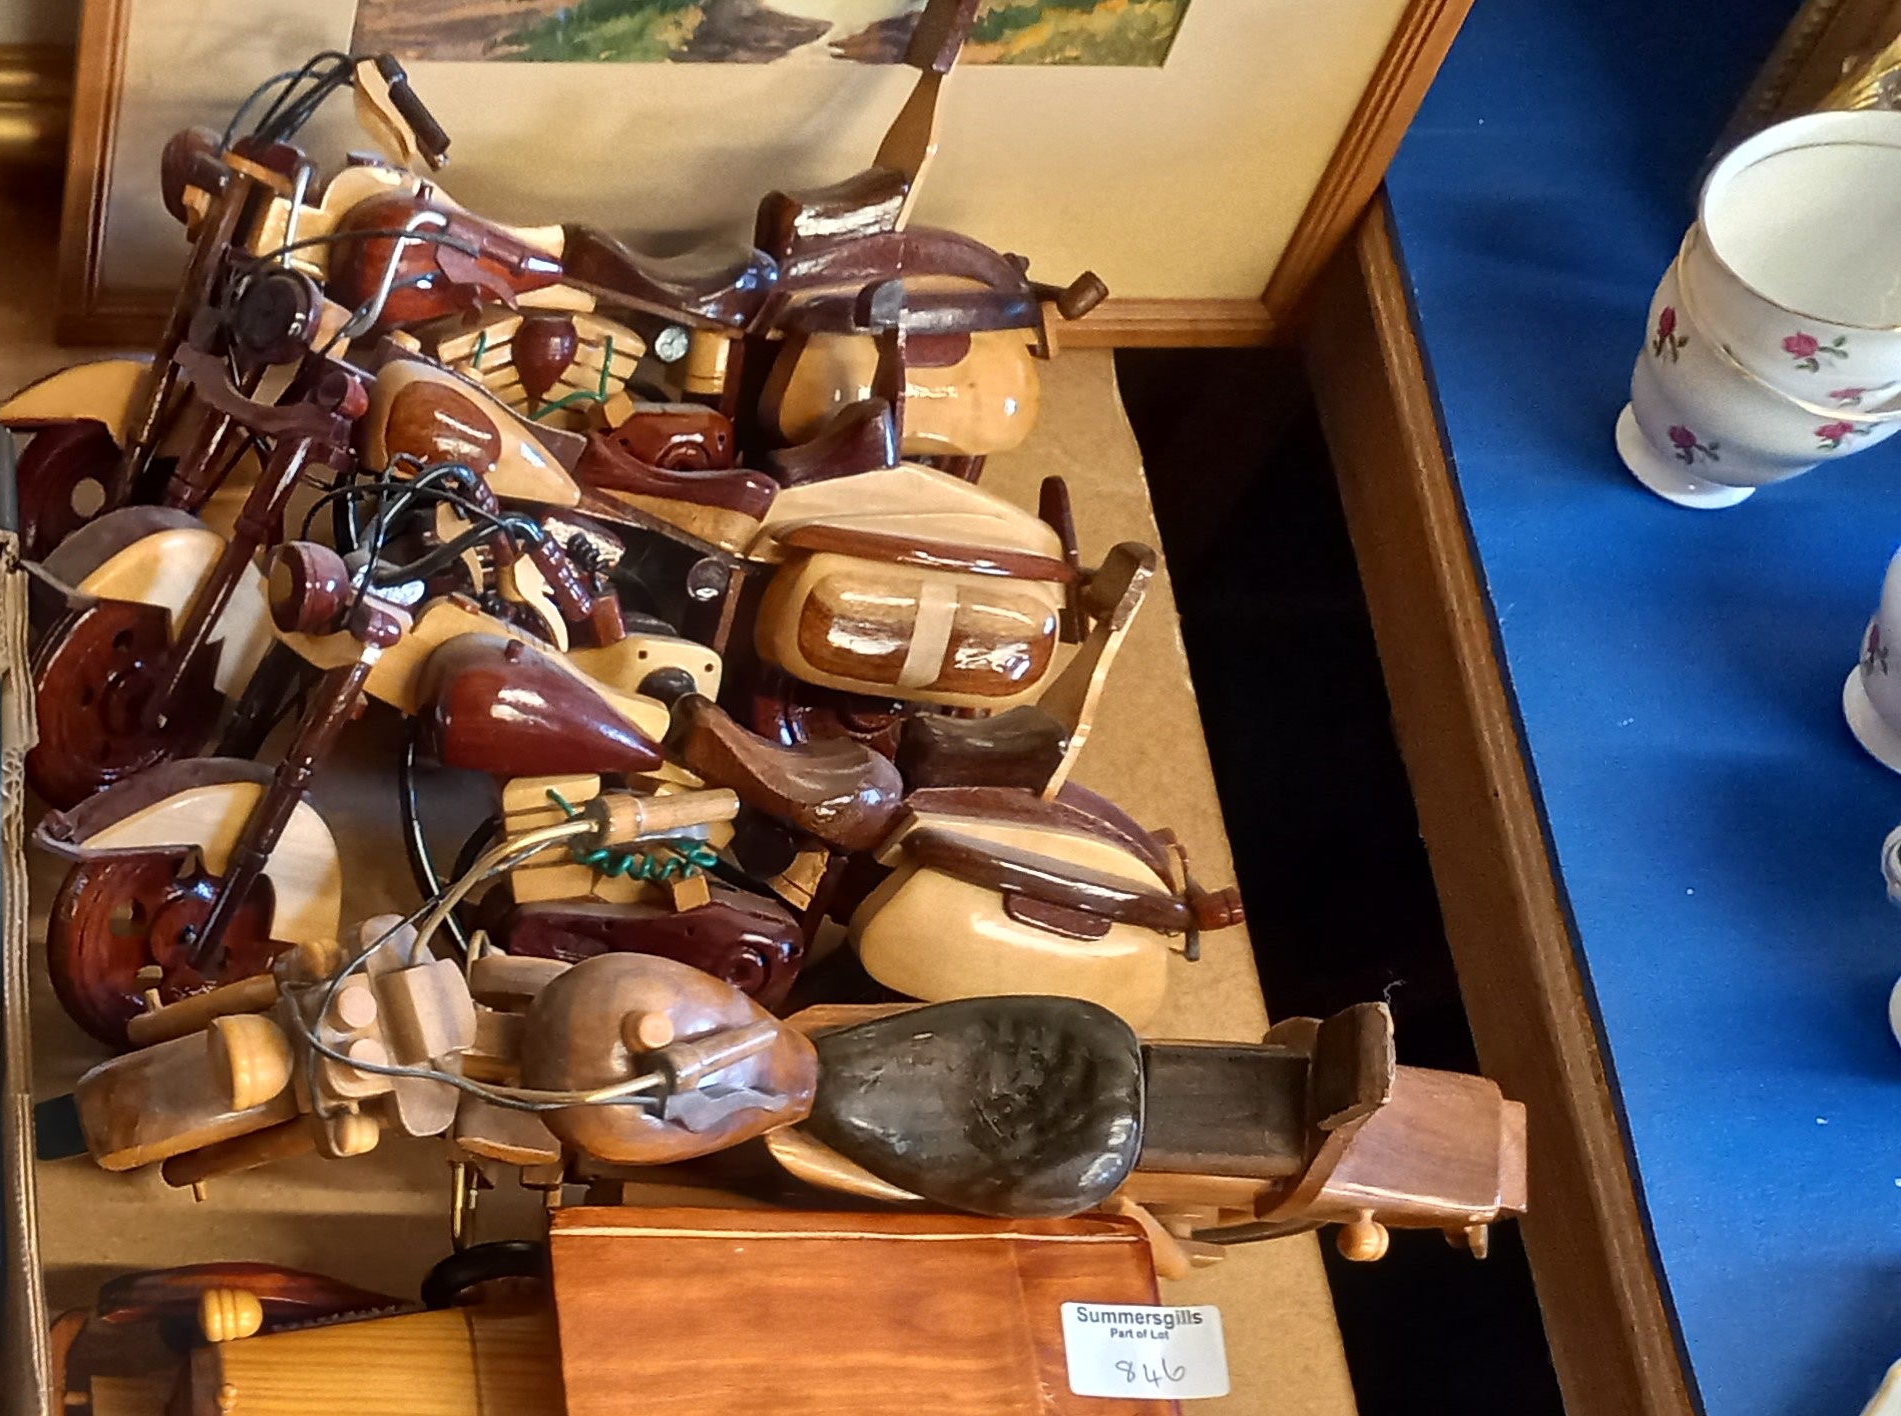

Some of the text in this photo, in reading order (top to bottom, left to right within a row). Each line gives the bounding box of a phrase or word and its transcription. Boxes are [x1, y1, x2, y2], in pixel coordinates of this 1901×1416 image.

[1077, 1306, 1204, 1330] Summersgills
[1110, 1327, 1170, 1340] Part of Lot
[1114, 1357, 1186, 1388] 846
